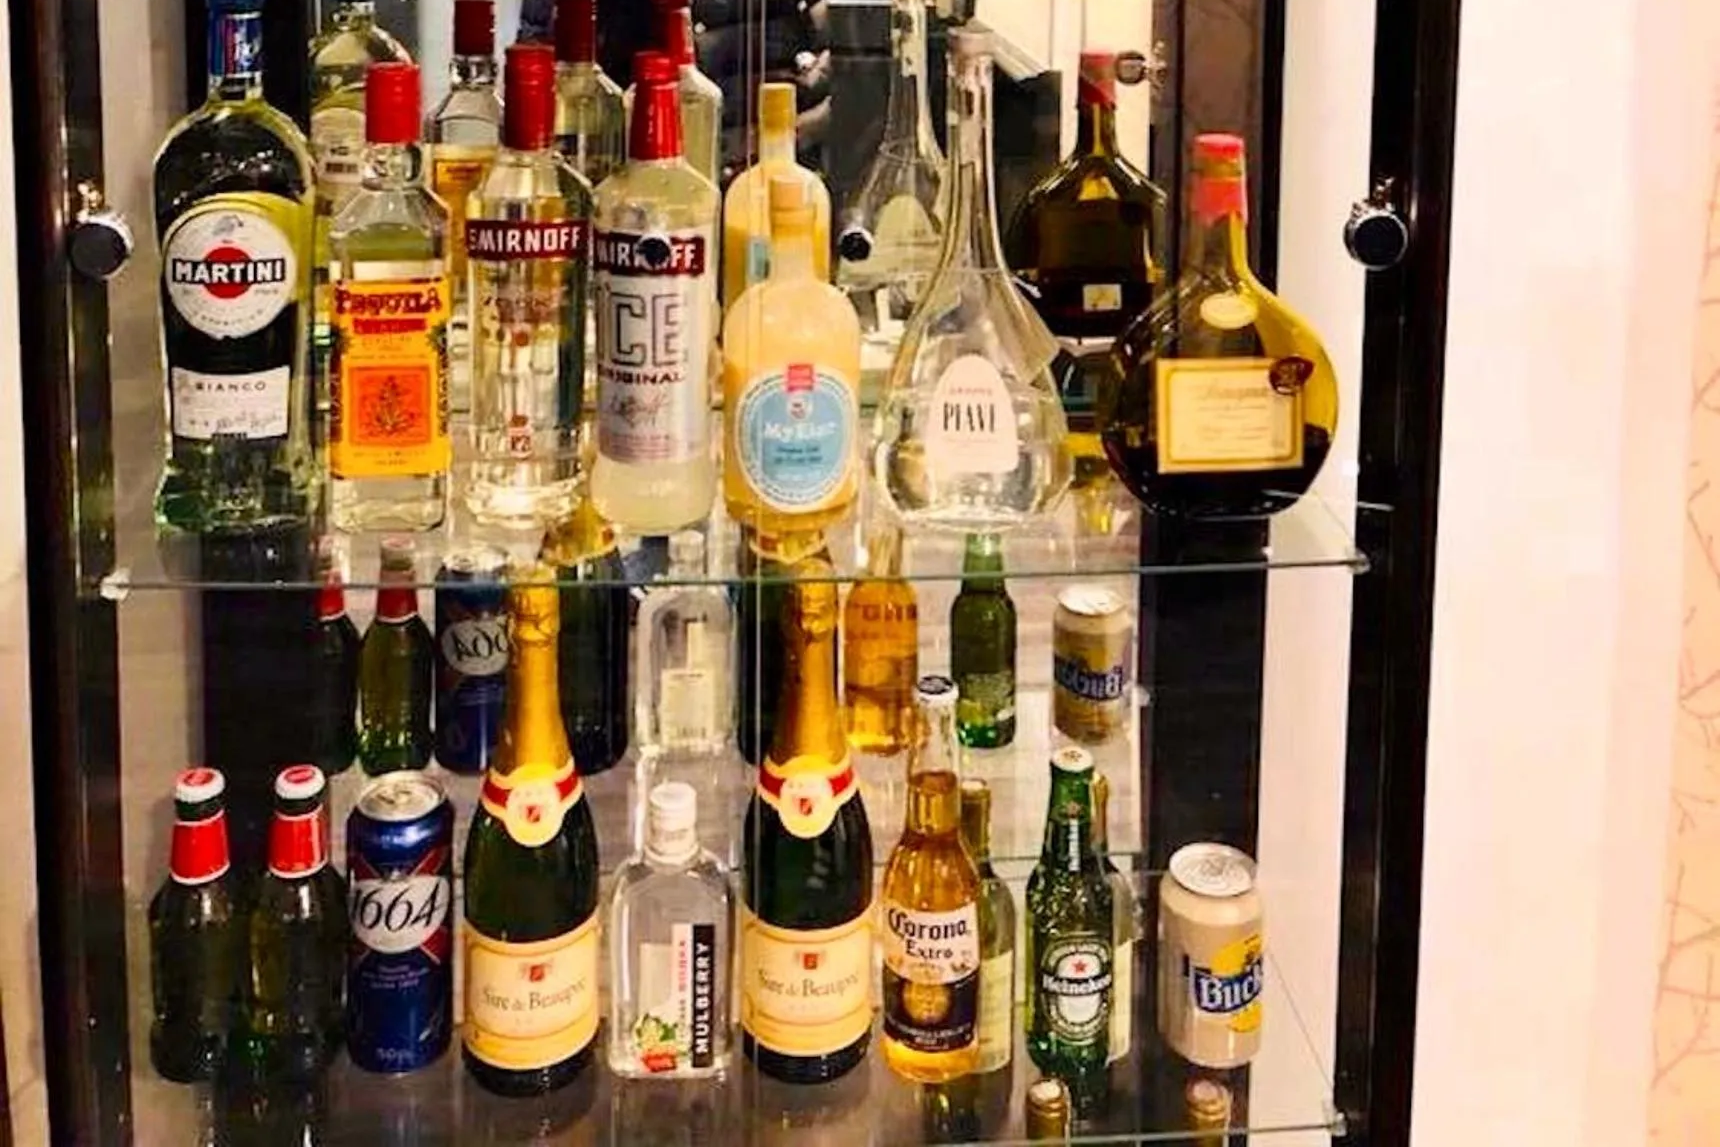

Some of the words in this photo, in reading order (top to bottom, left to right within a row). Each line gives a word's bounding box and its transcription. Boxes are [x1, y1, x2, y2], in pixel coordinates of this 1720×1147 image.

[469, 226, 581, 253] SMIRNOFF
[175, 259, 283, 284] MARTINI
[195, 380, 267, 393] BIANCO
[351, 882, 441, 933] 1664
[887, 907, 967, 941] Corona
[905, 938, 954, 960] Extra
[695, 943, 710, 1054] MULBERRY
